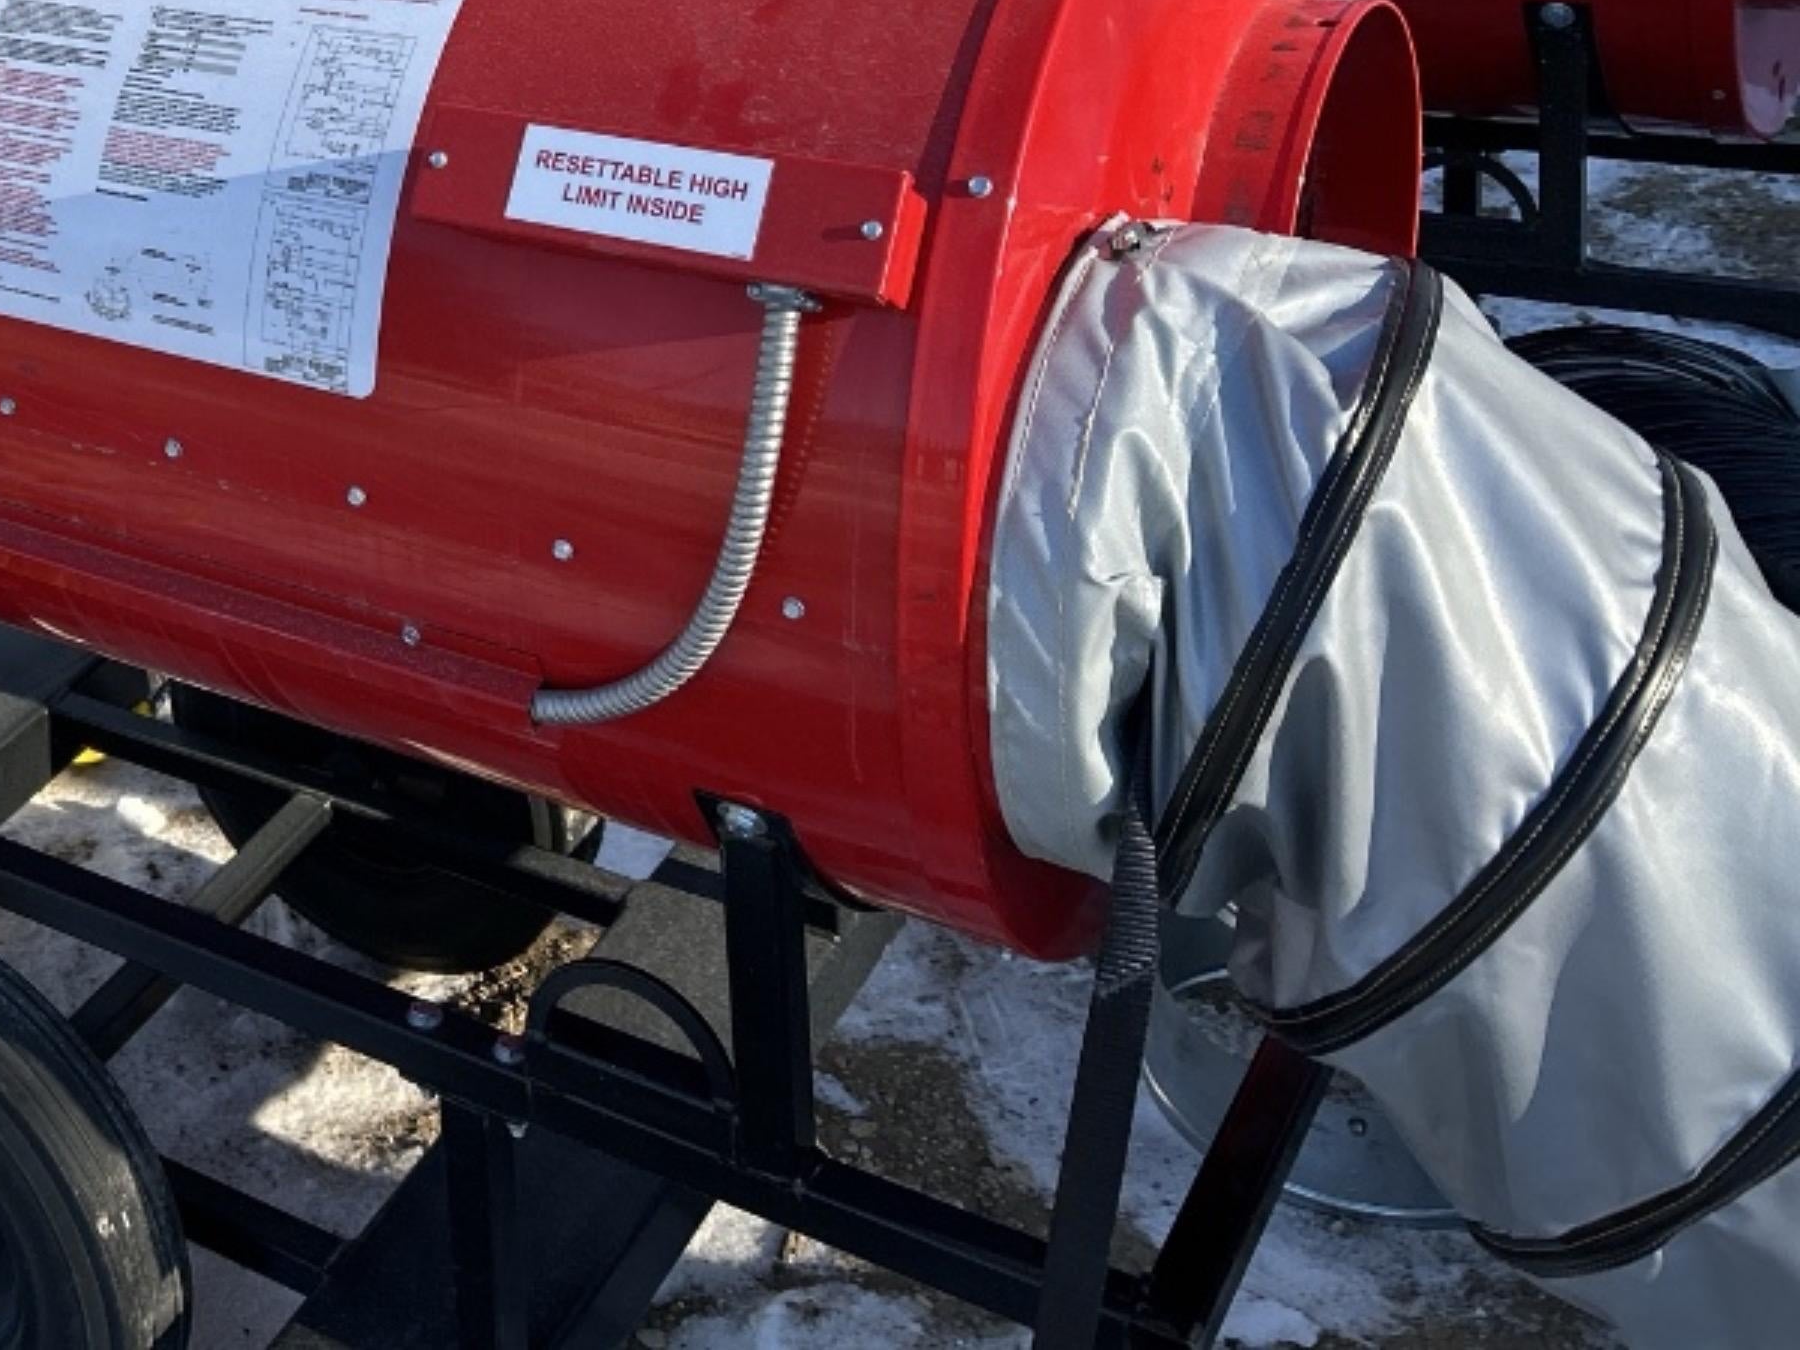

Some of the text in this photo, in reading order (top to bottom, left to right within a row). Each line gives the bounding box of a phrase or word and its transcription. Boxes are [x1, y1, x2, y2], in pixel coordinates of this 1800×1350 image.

[535, 148, 749, 201] RESETTABLE HIGH
[561, 182, 706, 226] LIMIT INSIDE
